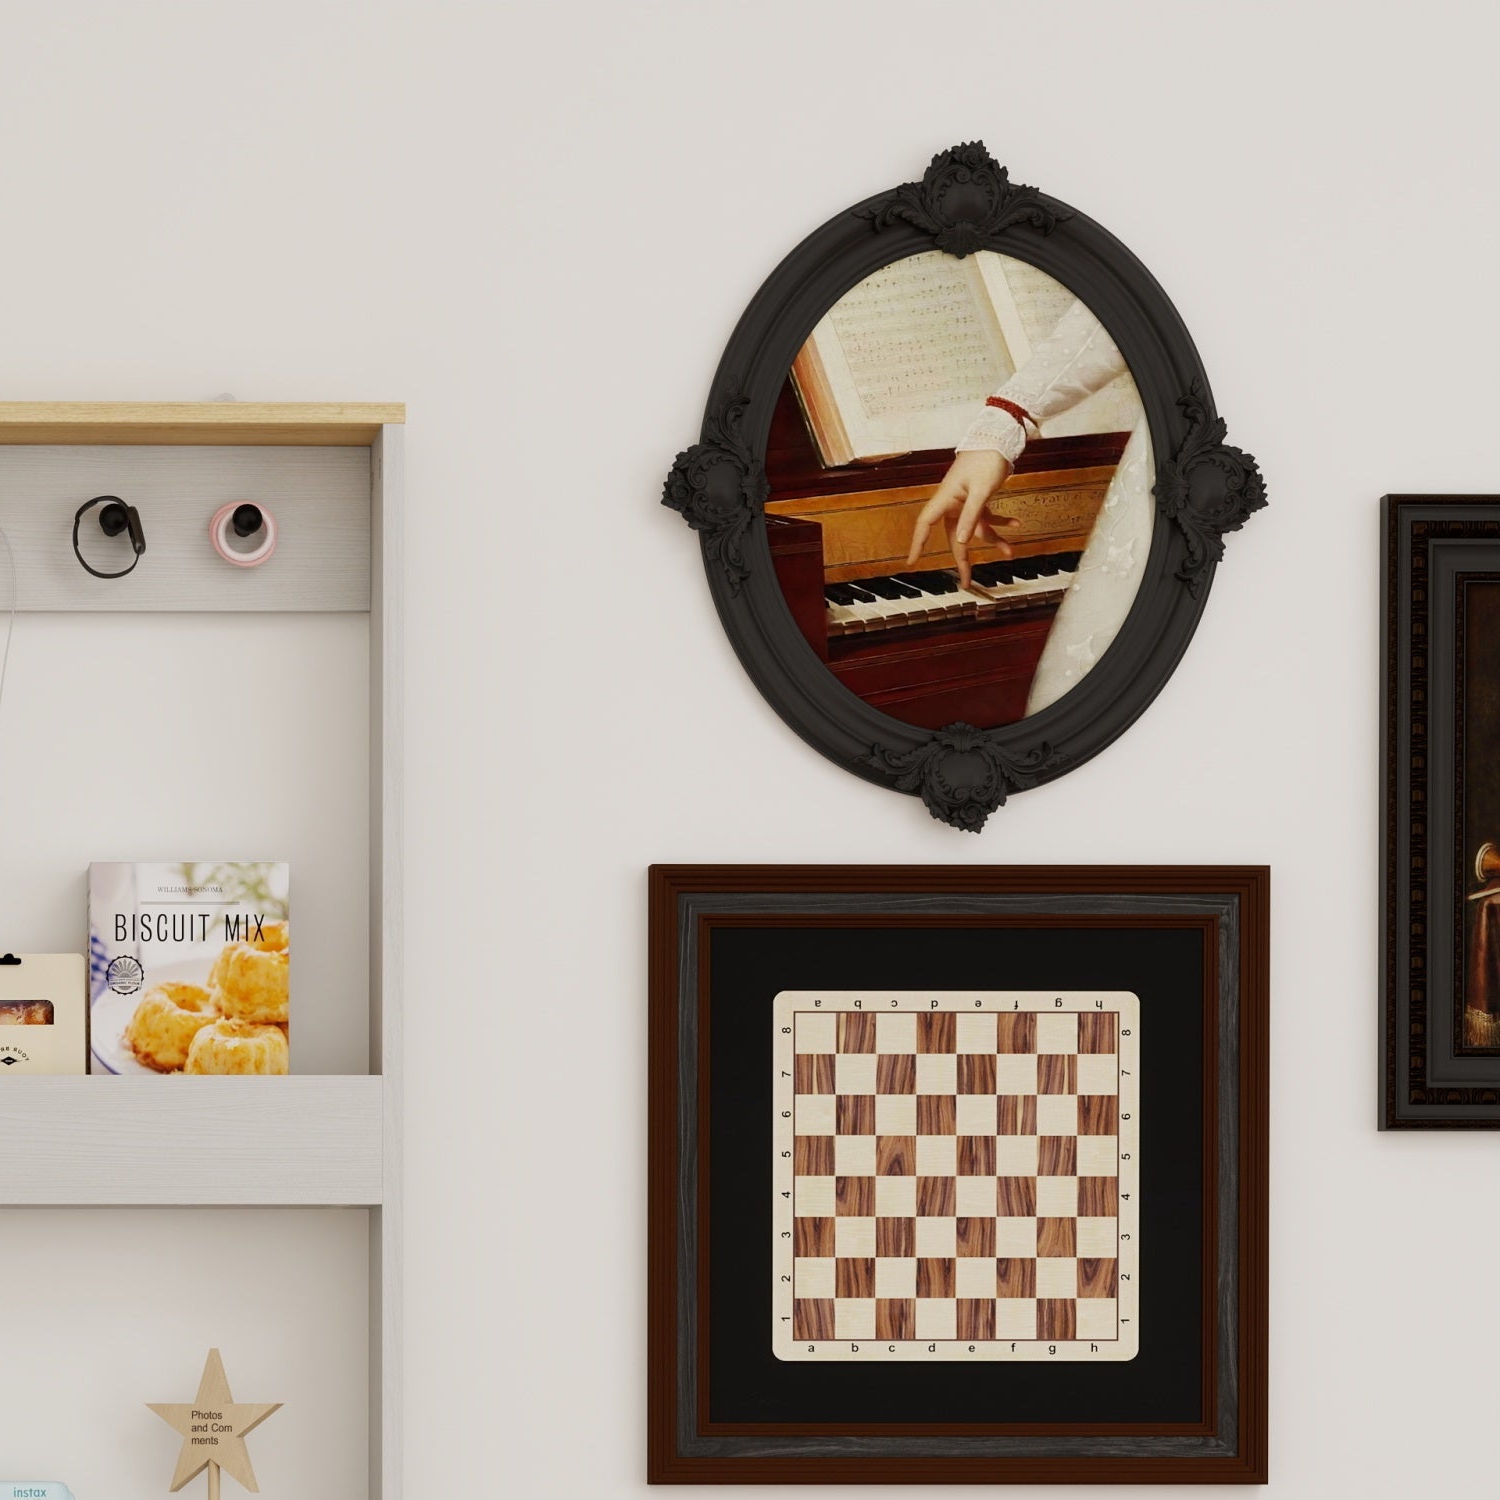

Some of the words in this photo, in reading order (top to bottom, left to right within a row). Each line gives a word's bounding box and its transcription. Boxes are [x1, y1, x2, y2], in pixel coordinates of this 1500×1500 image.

[114, 914, 210, 942] BISCUIT
[225, 914, 266, 942] MIX
[807, 1344, 815, 1353] a
[851, 1342, 860, 1353] b
[888, 1344, 896, 1353] c
[928, 1342, 936, 1353] d
[968, 1344, 976, 1353] e
[1010, 1342, 1016, 1353] f
[1048, 1344, 1057, 1356] g
[1090, 1342, 1098, 1353] h
[191, 1410, 223, 1420] Photos
[191, 1423, 208, 1432] and
[211, 1423, 233, 1432] Com
[191, 1436, 219, 1445] ments
[13, 1487, 47, 1498] instax
